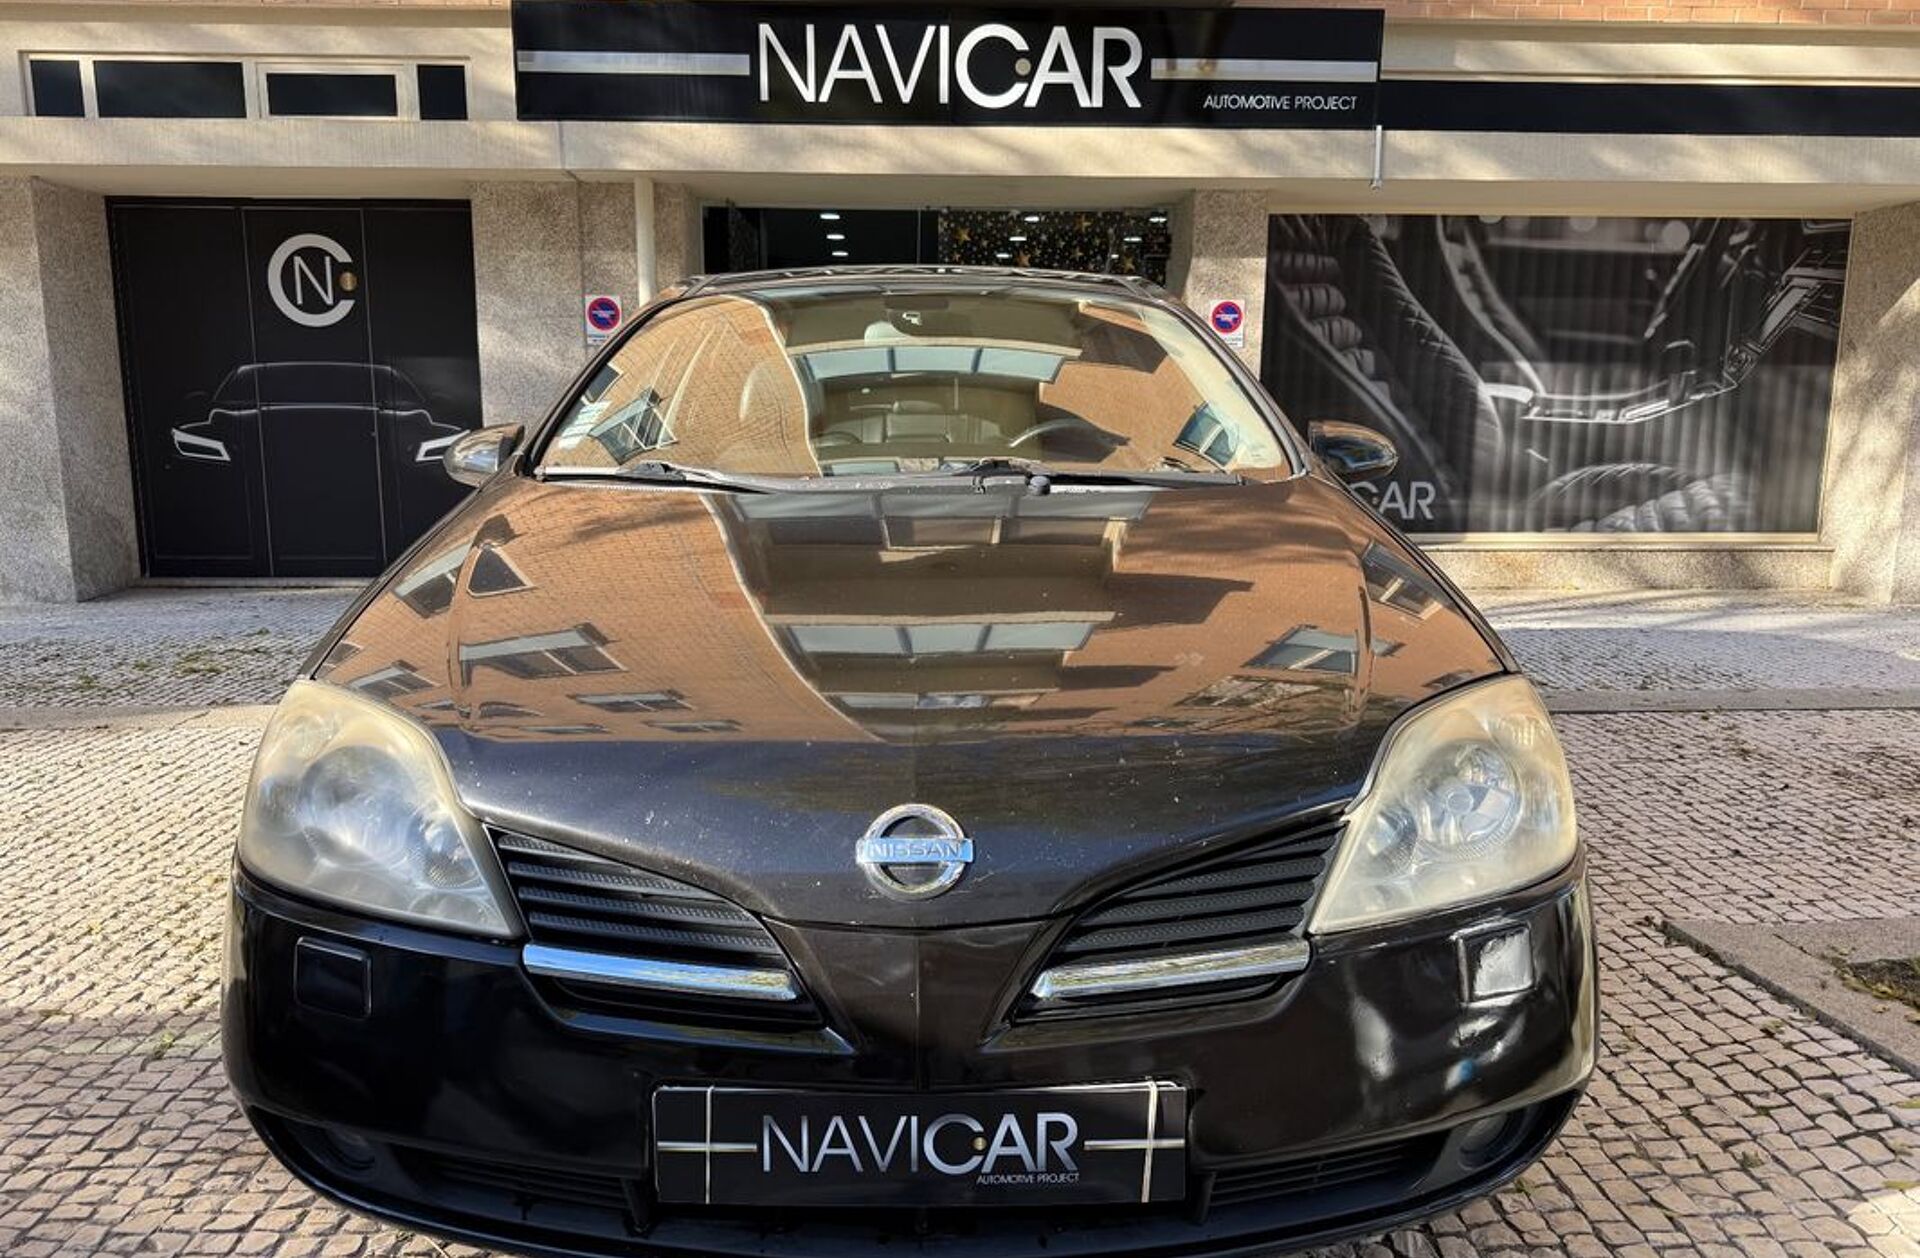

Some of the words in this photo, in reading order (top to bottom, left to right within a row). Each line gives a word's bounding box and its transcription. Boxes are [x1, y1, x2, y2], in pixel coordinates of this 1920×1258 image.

[758, 23, 1143, 108] NAVICAR
[1203, 94, 1290, 110] AUTOMOTIVE
[1294, 95, 1357, 110] PROJECT
[868, 841, 961, 858] NISSAN
[763, 1112, 1078, 1174] NAVICAR
[976, 1174, 1036, 1185] AUTOMOTIVE
[1037, 1172, 1079, 1184] PROJECT
